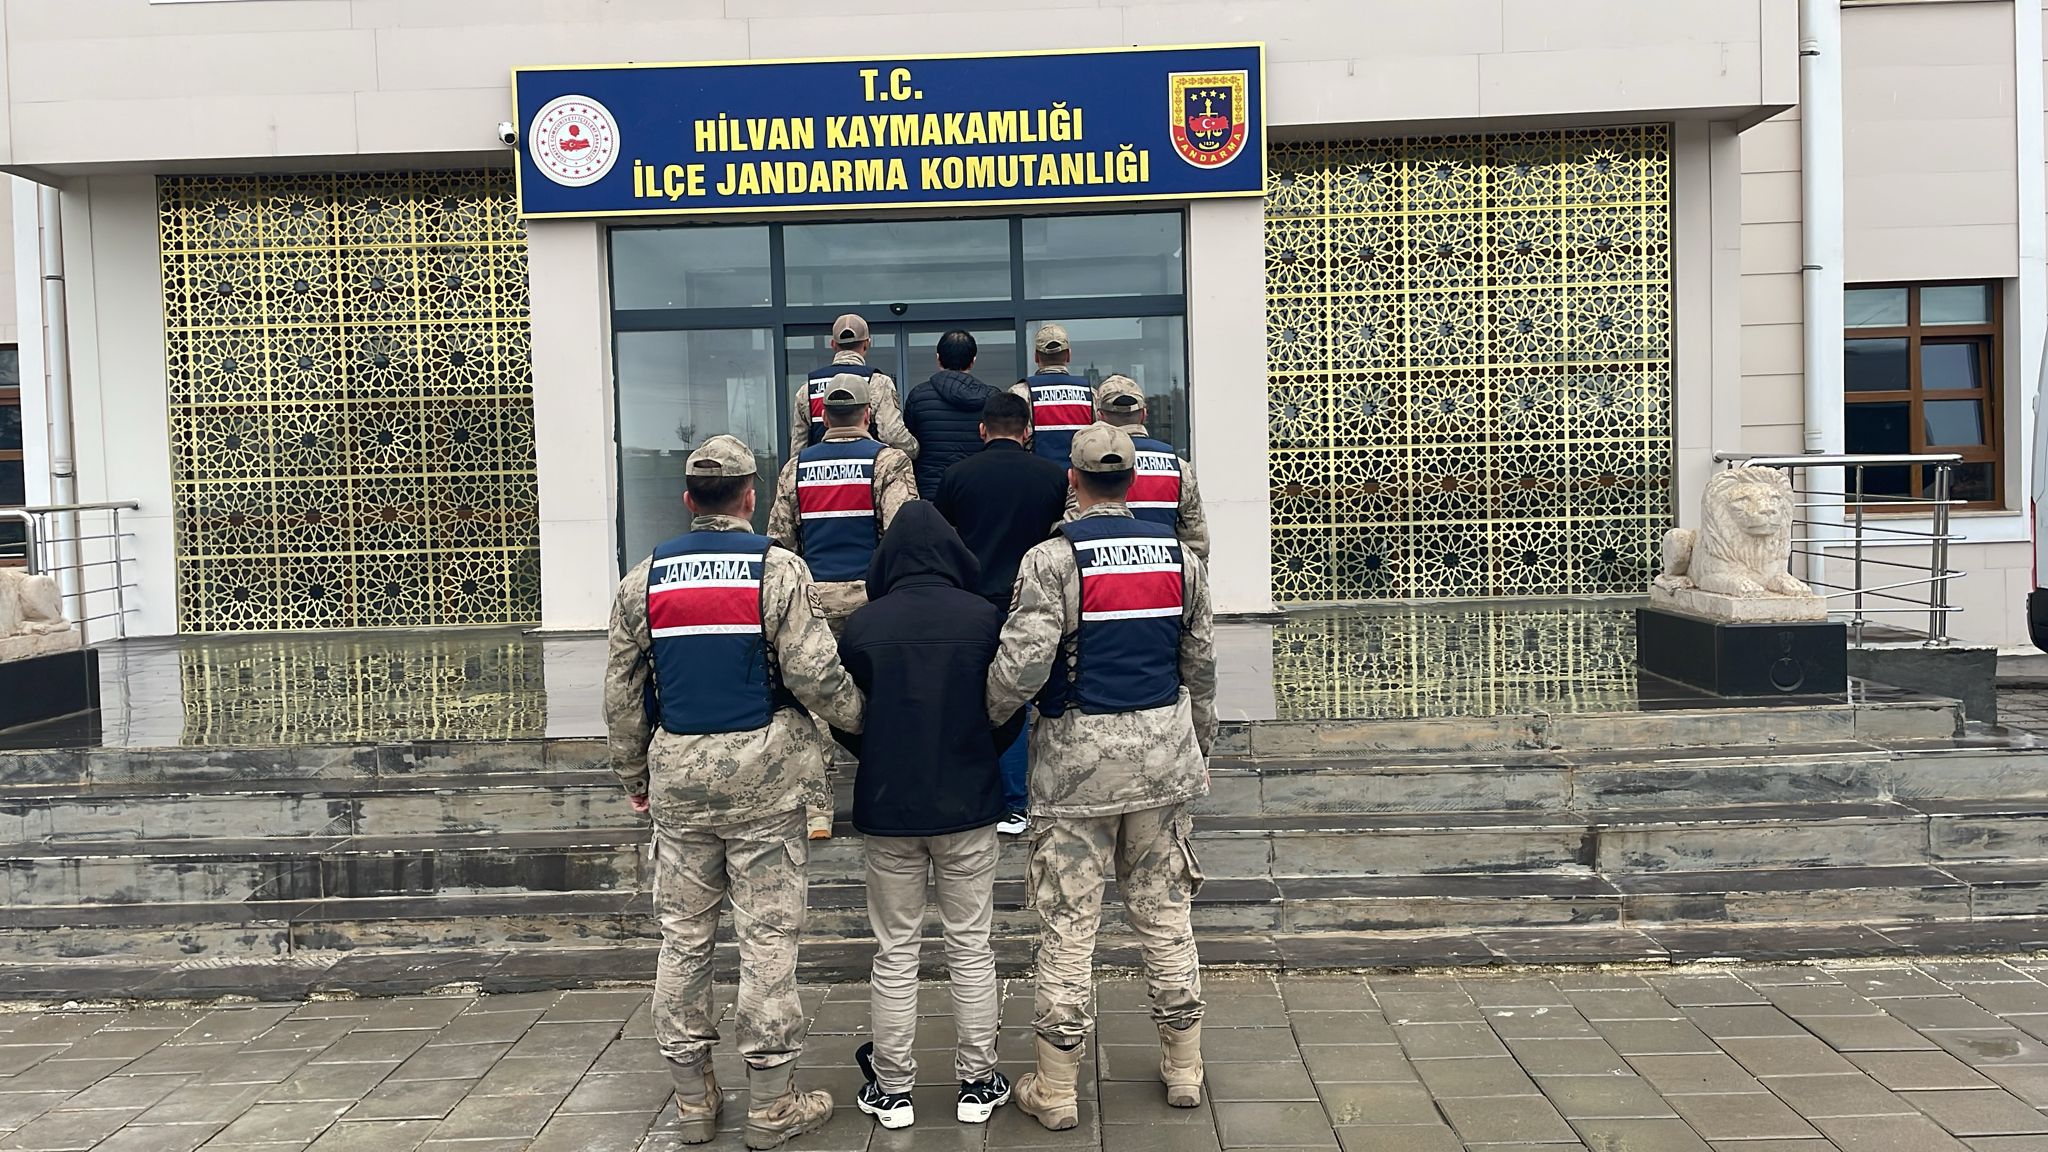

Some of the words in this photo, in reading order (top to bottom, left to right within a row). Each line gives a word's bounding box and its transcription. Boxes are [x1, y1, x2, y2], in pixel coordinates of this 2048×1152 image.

[860, 67, 923, 102] T.C.
[694, 112, 815, 153] HİLVAN
[826, 101, 1083, 149] KAYMAKAMLIĞI
[1177, 133, 1242, 162] JANDARMA
[633, 159, 706, 203] İLÇE
[717, 158, 909, 196] JANDARMA
[921, 143, 1149, 190] KOMUTANLIĞI
[1038, 389, 1087, 401] JANDARMA
[802, 464, 864, 481] JANDARMA
[1135, 456, 1174, 470] DARMA
[1090, 545, 1173, 567] JANDARMA
[660, 560, 752, 584] JANDARMA
